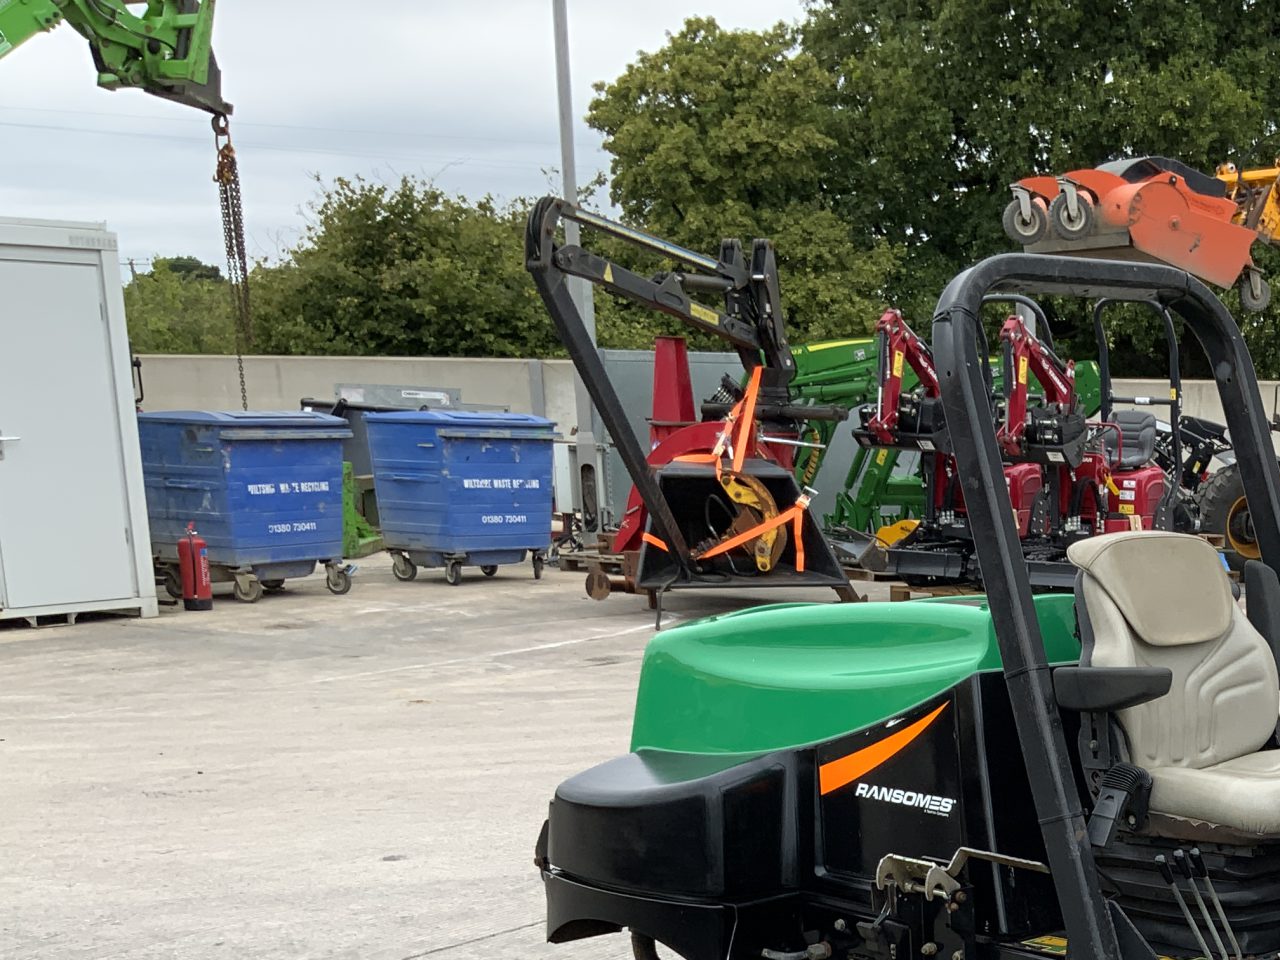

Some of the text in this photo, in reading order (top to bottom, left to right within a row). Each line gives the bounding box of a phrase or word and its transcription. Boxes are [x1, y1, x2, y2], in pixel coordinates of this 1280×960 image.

[280, 483, 300, 494] WATE
[300, 482, 329, 492] RECYCLING
[493, 479, 511, 488] WASTE
[512, 479, 540, 488] RELING
[482, 516, 504, 524] 01380
[292, 522, 316, 531] 730411
[855, 783, 953, 812] RANSOMES
